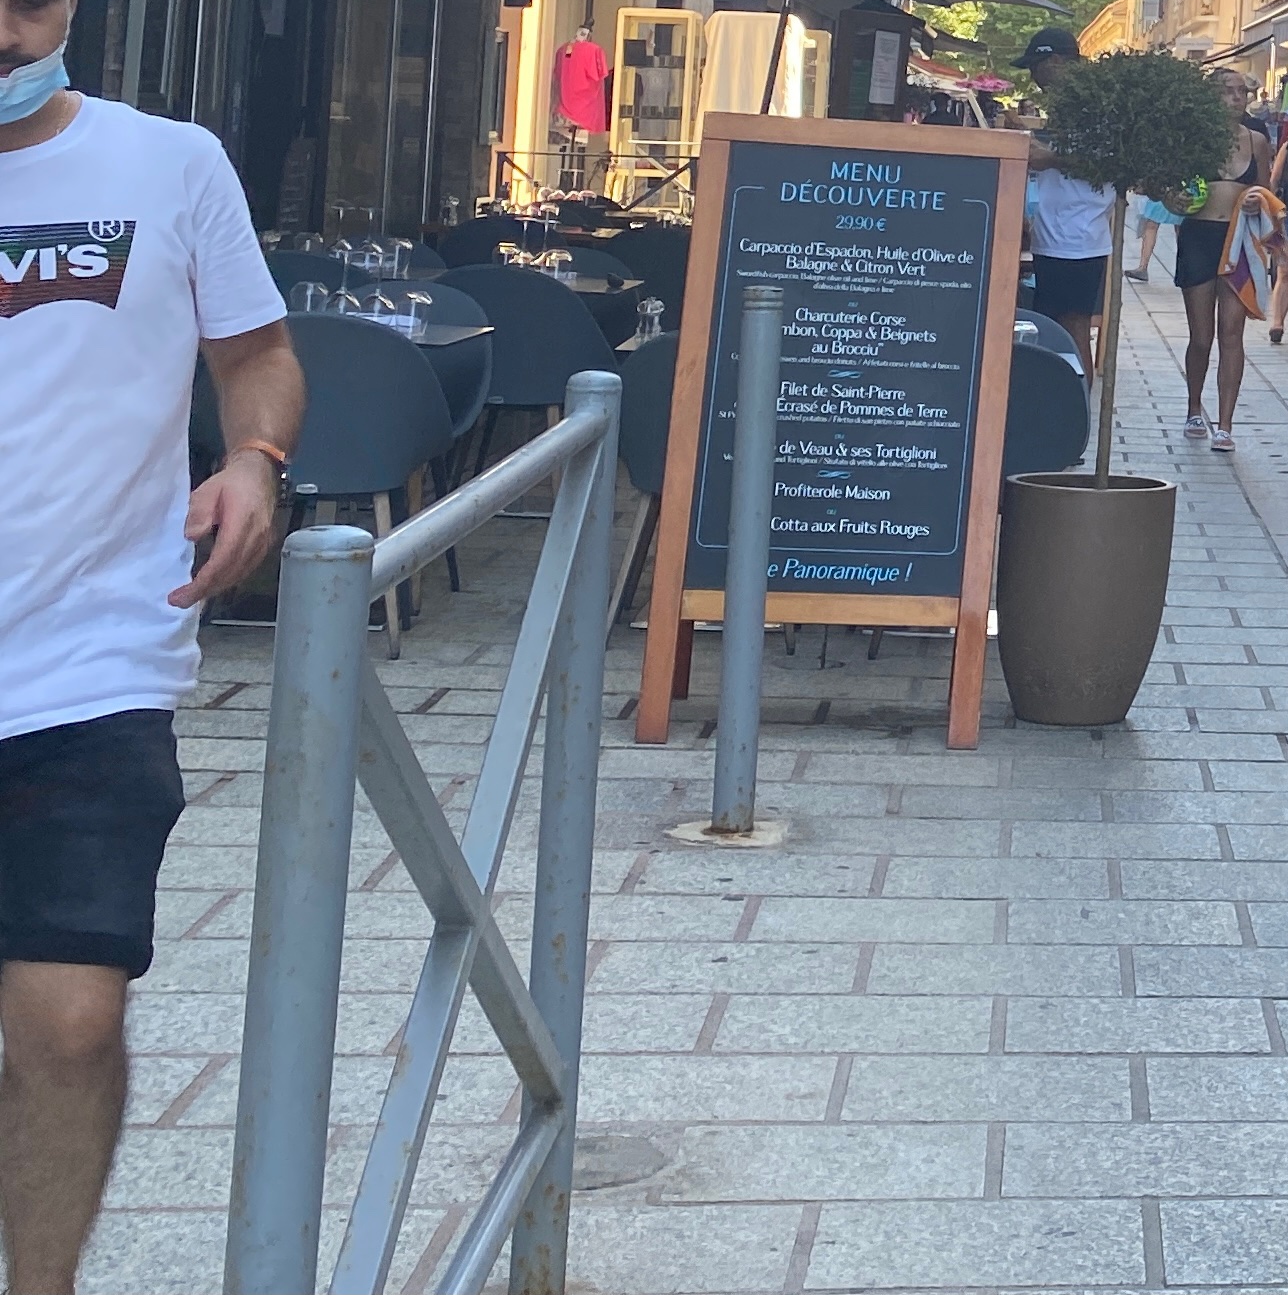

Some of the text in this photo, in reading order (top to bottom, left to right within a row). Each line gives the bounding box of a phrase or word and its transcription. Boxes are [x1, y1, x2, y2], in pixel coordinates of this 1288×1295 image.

[830, 161, 901, 184] MENU
[780, 179, 947, 211] DÉCOUVERTE
[876, 217, 887, 232] €
[740, 237, 802, 256] Carpaccio
[876, 246, 909, 261] Huile
[911, 247, 955, 263] d'Olive
[957, 250, 974, 264] de
[0, 244, 109, 283] VI'S
[786, 255, 926, 276] Balagne & Citron Vert
[795, 307, 907, 327] Charcuterie Corse
[781, 321, 937, 345] mbon, Coppa & Beignets
[811, 343, 828, 354] au
[781, 381, 906, 400] Filet de Saint-Pierre
[776, 394, 948, 419] Écrasé de Pommes de Terre
[779, 440, 937, 462] de Veau & ses Tortiglioni
[774, 482, 891, 501] Profiterole Maison
[770, 516, 930, 539] Cotta aux Fruits Rouges
[767, 563, 778, 578] e
[782, 558, 900, 586] Panoramique
